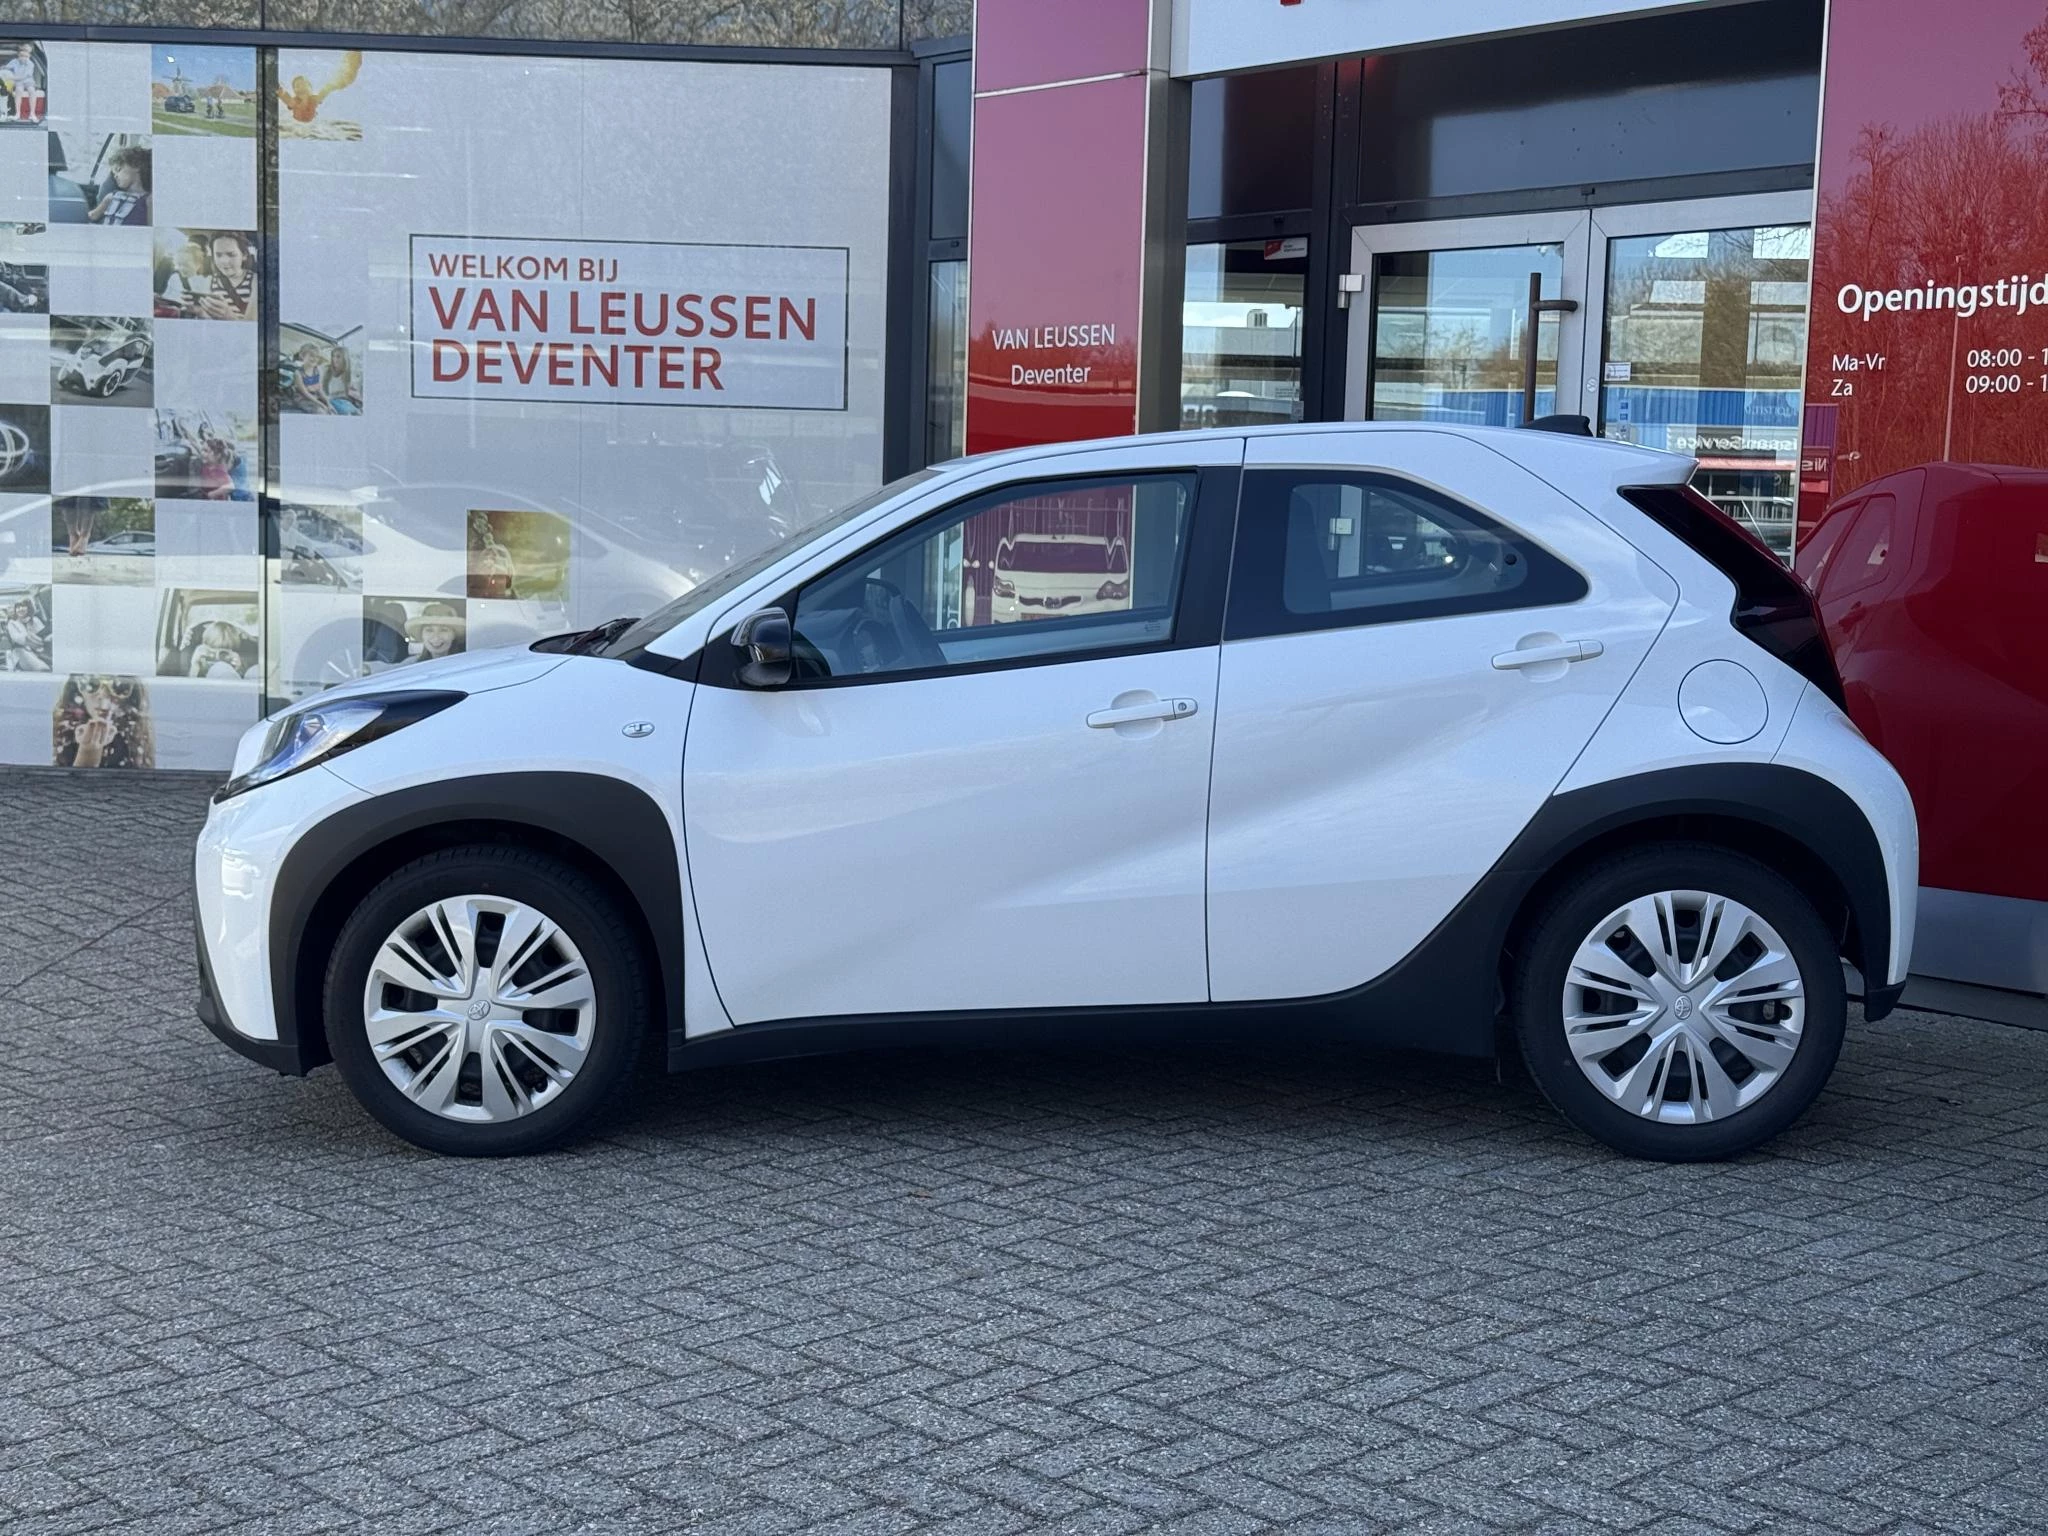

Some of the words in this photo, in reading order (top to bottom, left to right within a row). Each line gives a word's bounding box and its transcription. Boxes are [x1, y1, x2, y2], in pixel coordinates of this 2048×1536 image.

[428, 253, 568, 281] WELKOM
[579, 258, 618, 283] BIJ
[428, 286, 548, 333] VAN
[569, 290, 816, 341] LEUSSEN
[992, 328, 1029, 350] VAN
[1034, 323, 1116, 349] LEUSSEN
[432, 339, 725, 390] DEVENTER
[1832, 353, 1886, 372] Ma-Vr
[1967, 349, 2023, 368] 08:00
[1011, 363, 1091, 386] Deventer
[1830, 379, 1853, 397] Za
[1965, 375, 2021, 394] 09:00
